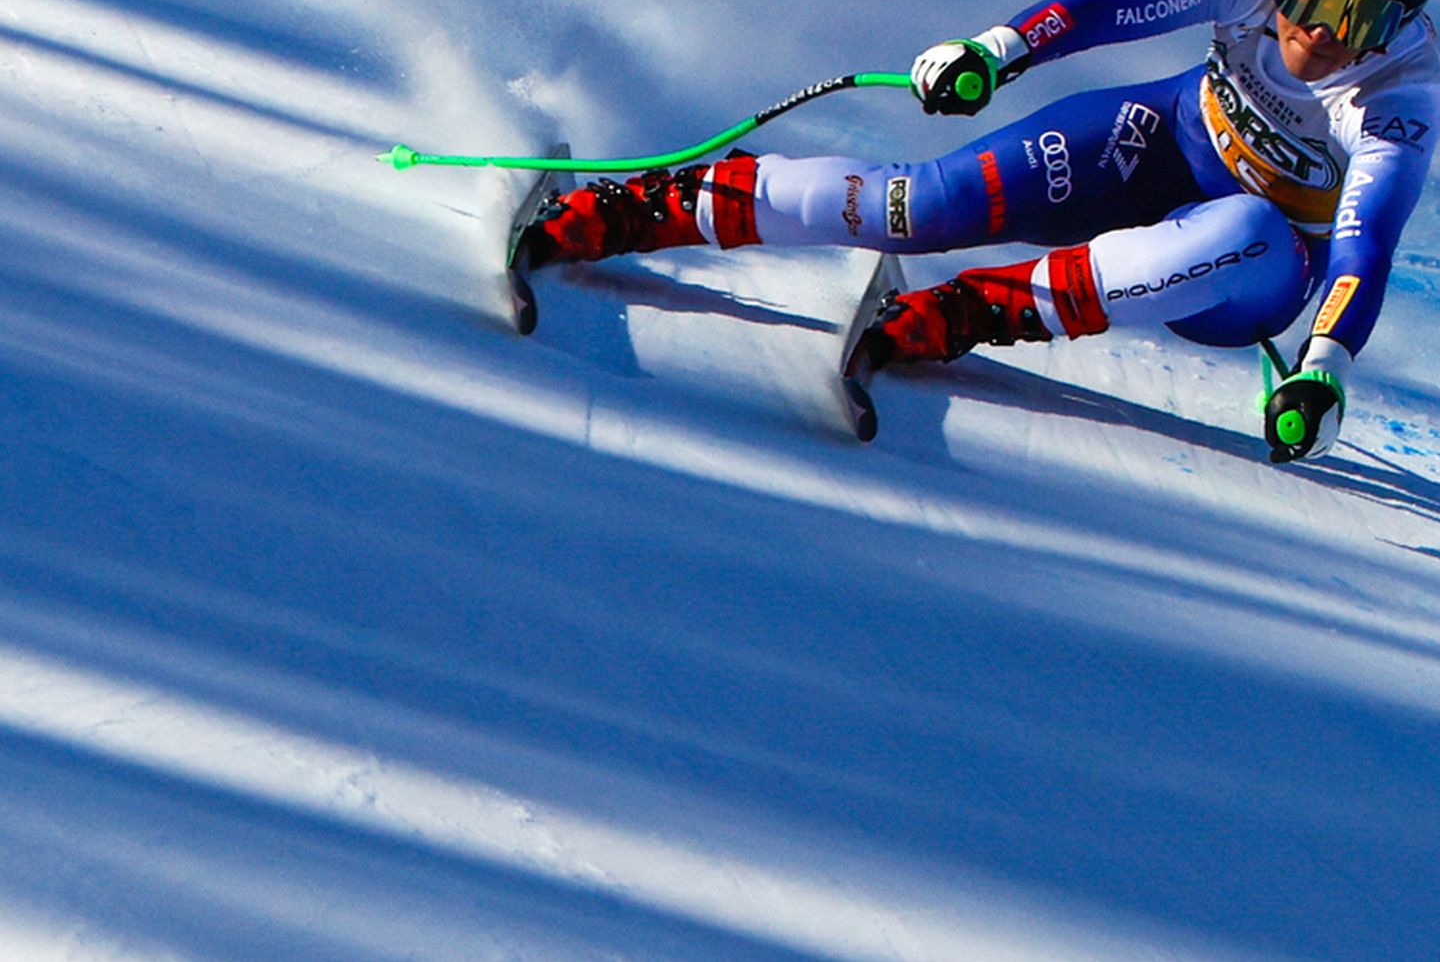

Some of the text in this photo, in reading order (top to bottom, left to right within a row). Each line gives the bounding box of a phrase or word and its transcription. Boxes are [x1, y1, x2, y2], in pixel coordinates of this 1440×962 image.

[1026, 9, 1067, 48] enel
[1022, 139, 1039, 170] Audi
[1113, 103, 1161, 183] EA7
[1360, 115, 1430, 144] EA7
[889, 178, 909, 238] FORST
[1335, 170, 1374, 240] Audi
[1107, 241, 1269, 302] PIQUADRO
